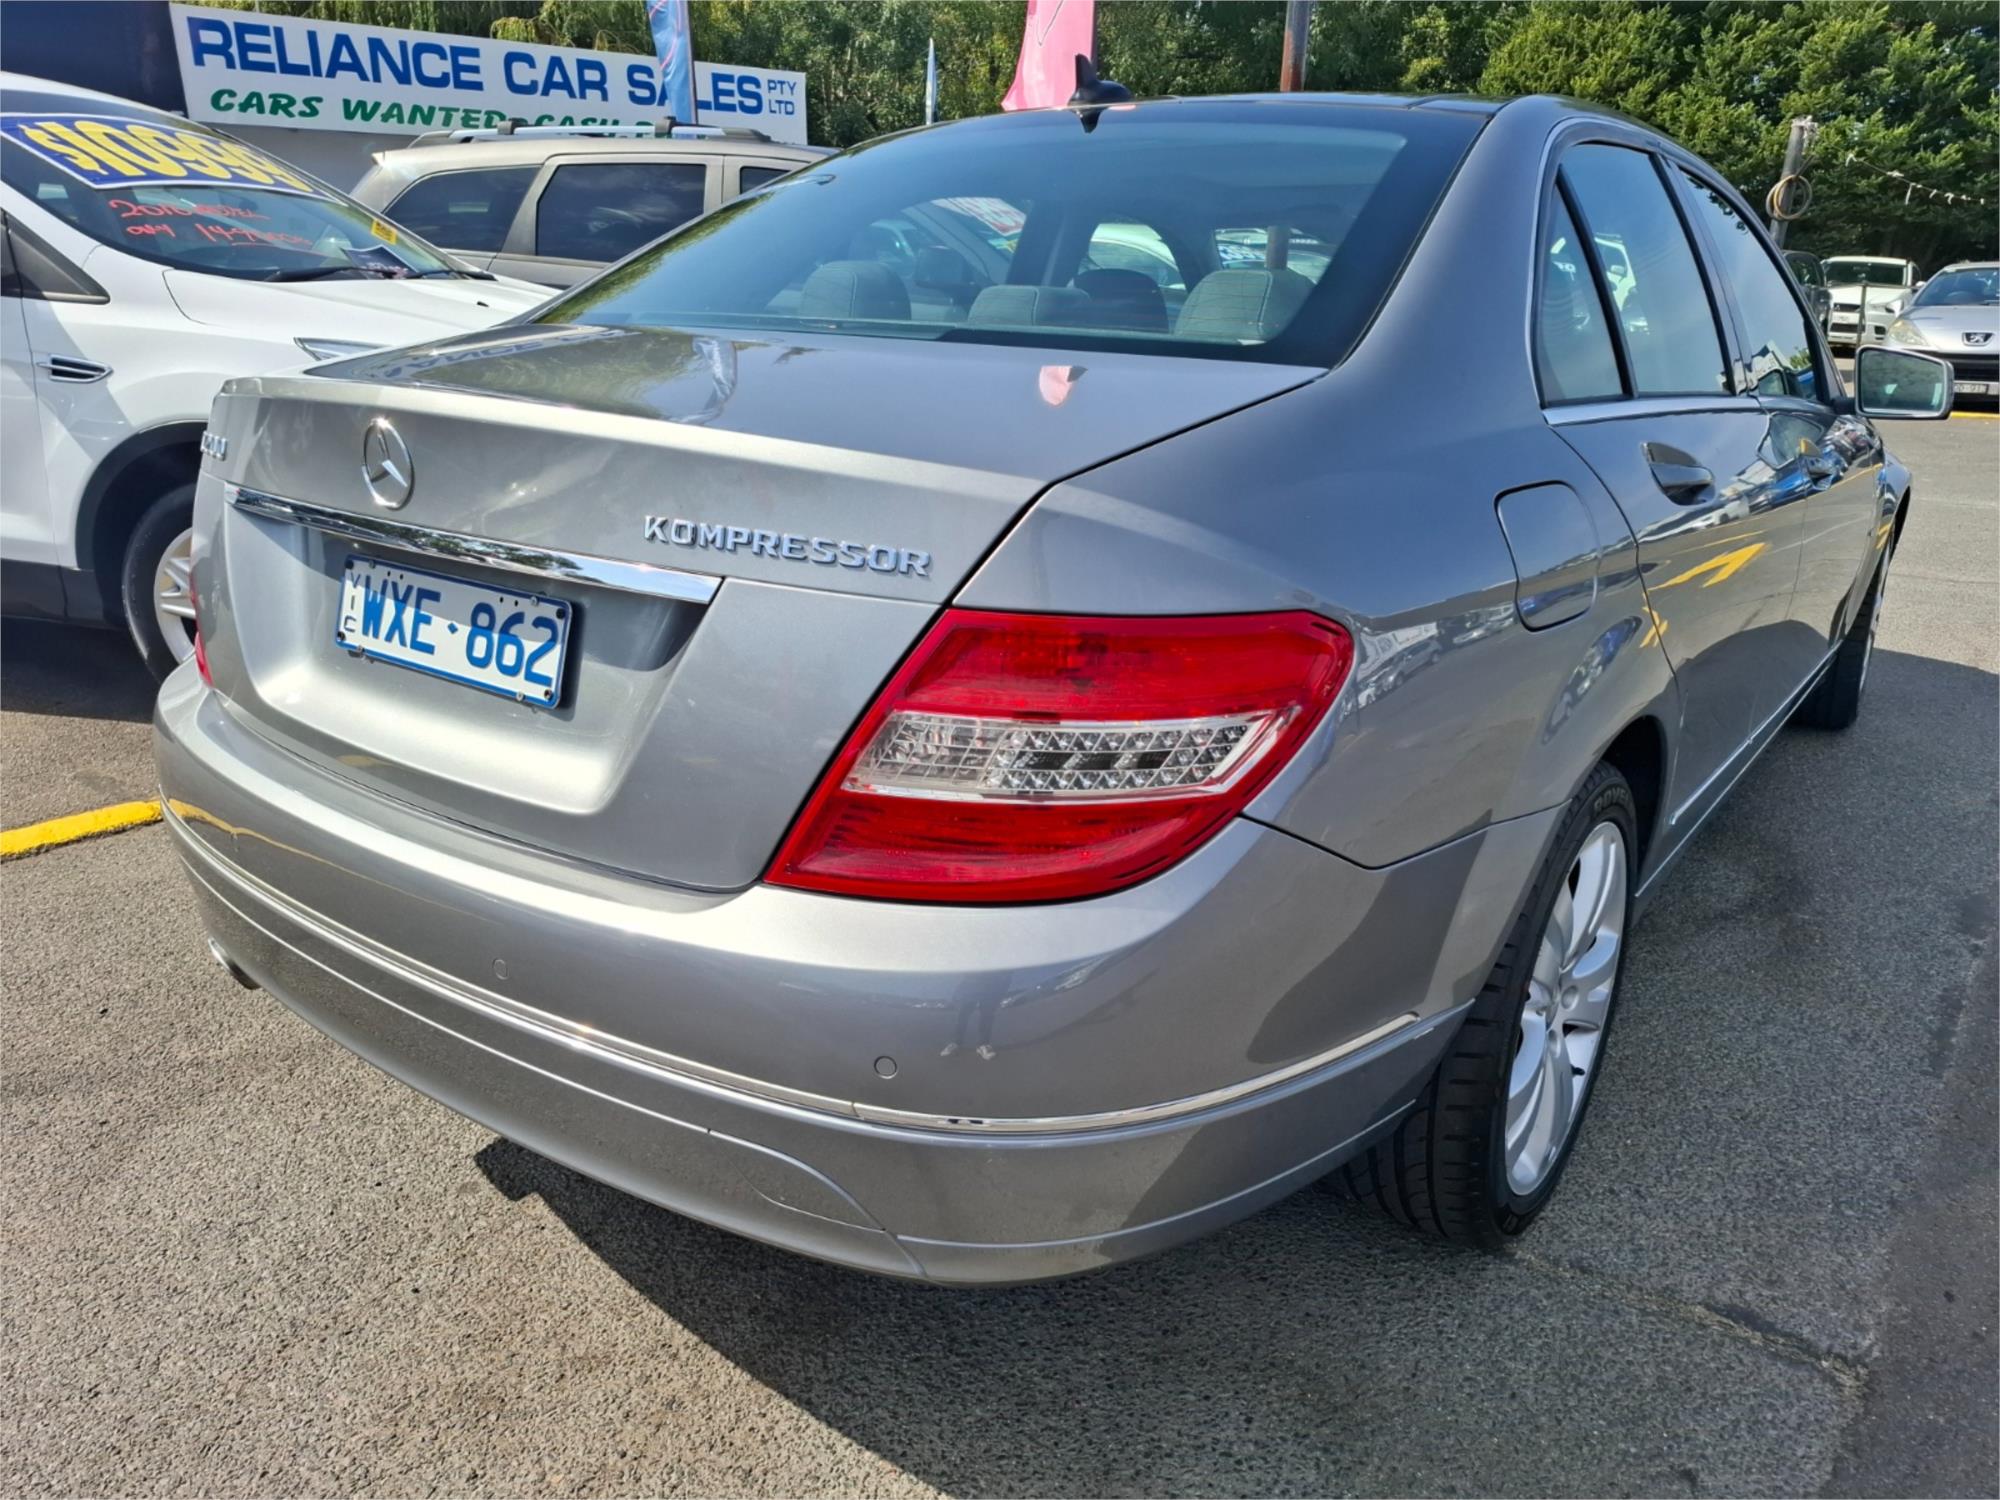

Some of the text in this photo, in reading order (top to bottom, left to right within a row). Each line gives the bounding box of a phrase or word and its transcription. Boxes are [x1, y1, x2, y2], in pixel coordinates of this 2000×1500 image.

[186, 16, 764, 115] RELIANCE CAR SES
[767, 79, 797, 96] PTY
[210, 89, 323, 118] CARS
[342, 98, 508, 129] WANTED
[768, 99, 796, 116] LTD
[18, 120, 313, 193] $10999
[643, 515, 932, 577] KOMPRESSOR
[343, 572, 361, 634] VIC
